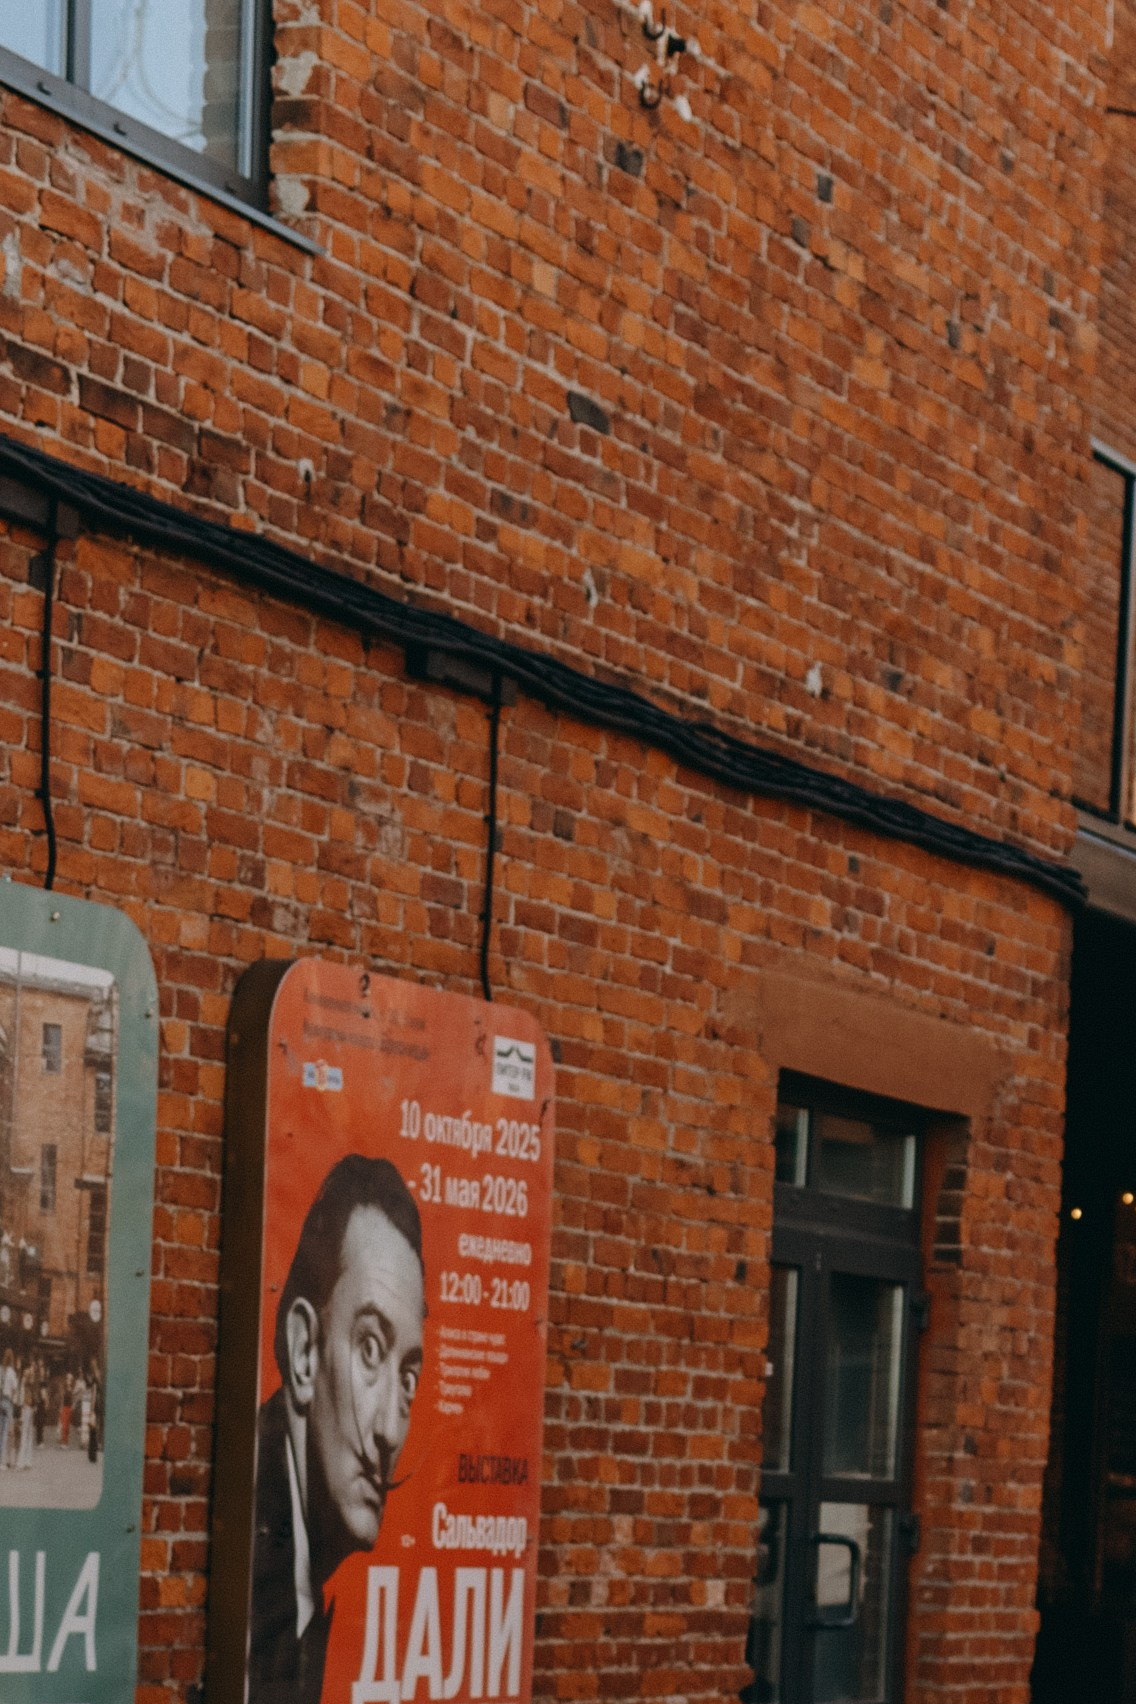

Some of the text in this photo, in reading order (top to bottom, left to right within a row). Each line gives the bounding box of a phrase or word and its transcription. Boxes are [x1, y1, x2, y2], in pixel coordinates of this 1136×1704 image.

[401, 1099, 541, 1162] 10 октября 2025
[419, 1162, 442, 1204] 31
[445, 1176, 481, 1209] мая
[482, 1174, 528, 1218] 2026
[458, 1232, 532, 1267] ежедневно
[440, 1271, 481, 1306] 12:00
[490, 1277, 530, 1311] 21:00
[458, 1453, 529, 1486] ВЫСТАВКА
[432, 1502, 527, 1558] Сальвадор
